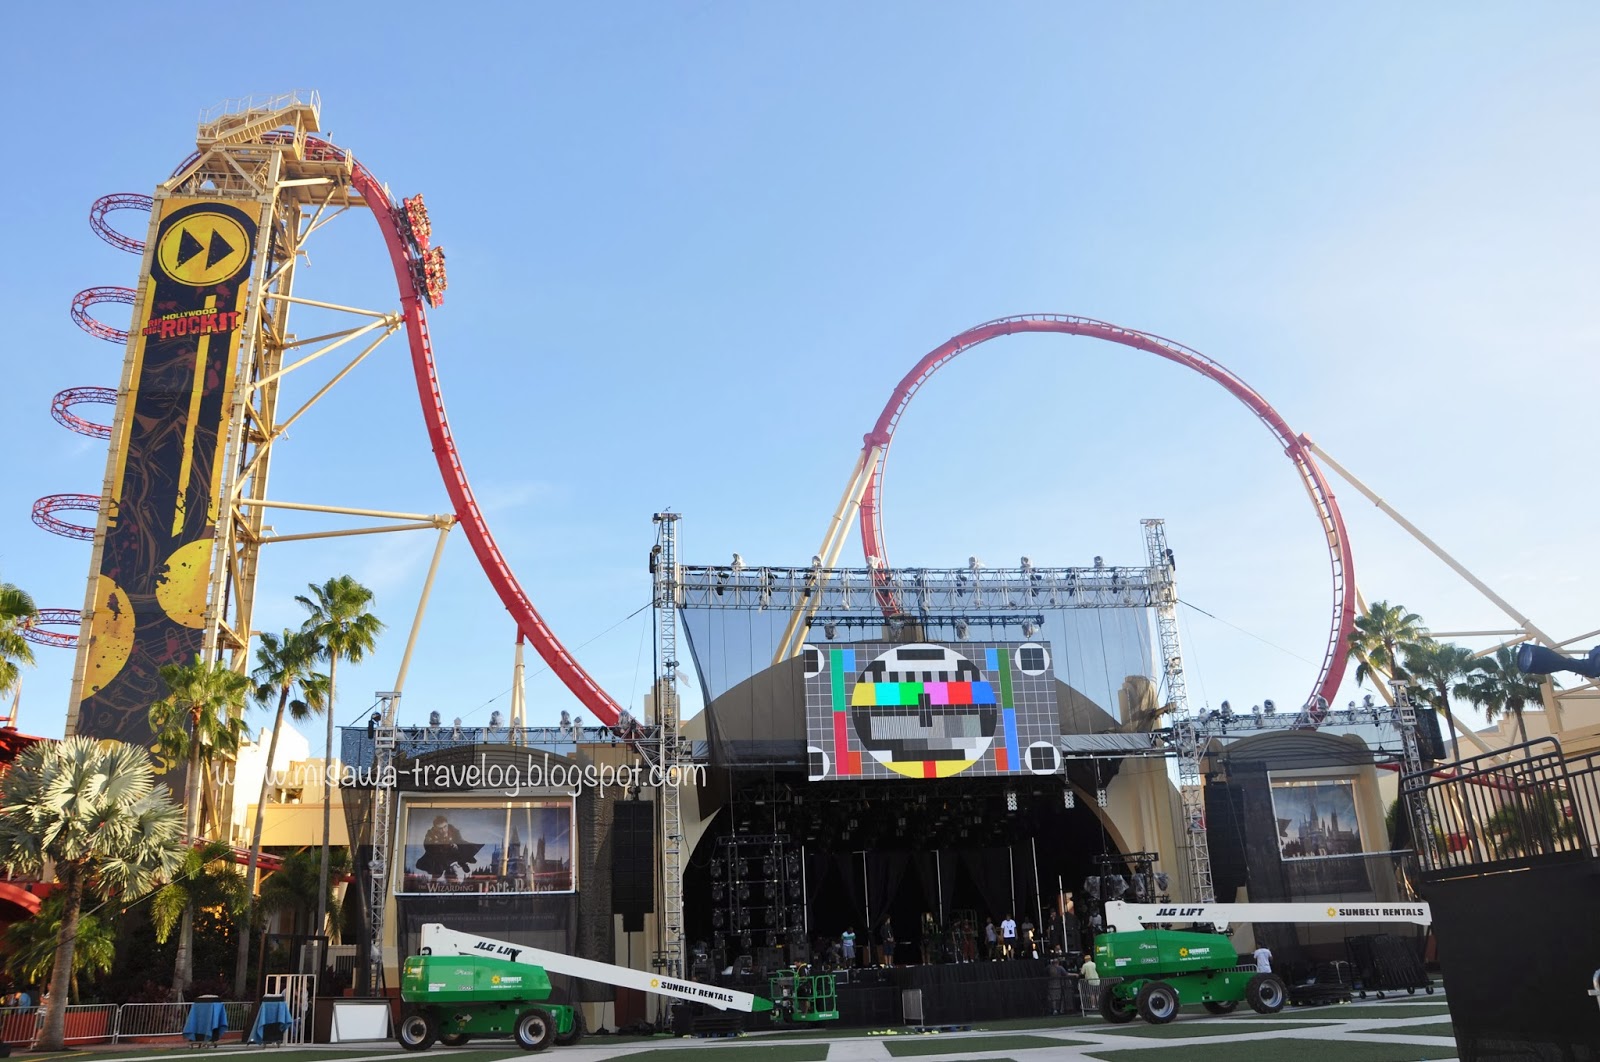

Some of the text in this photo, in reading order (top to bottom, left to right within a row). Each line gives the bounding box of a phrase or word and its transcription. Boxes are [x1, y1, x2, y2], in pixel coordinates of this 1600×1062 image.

[162, 308, 217, 320] HOLLYWOOD
[161, 312, 241, 339] ROCKIT
[474, 942, 496, 952] JLG
[661, 981, 734, 1003] SUNBELT RENTALS
